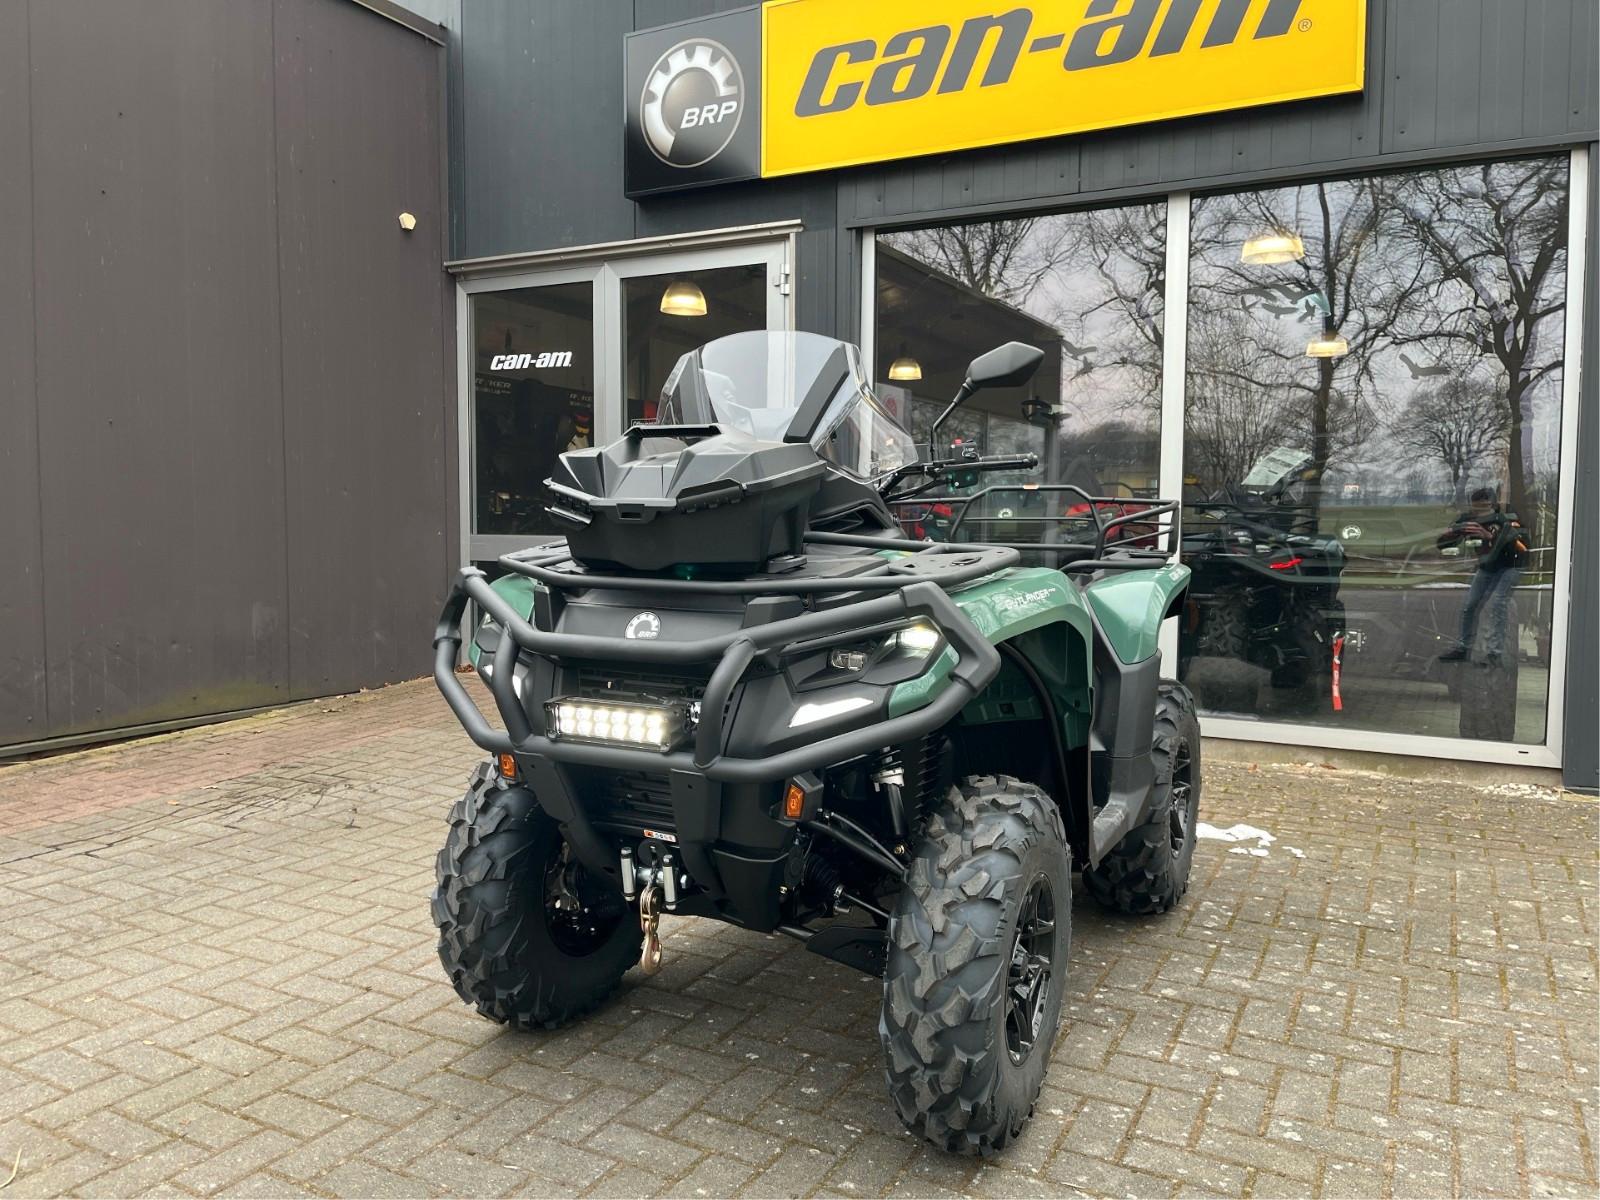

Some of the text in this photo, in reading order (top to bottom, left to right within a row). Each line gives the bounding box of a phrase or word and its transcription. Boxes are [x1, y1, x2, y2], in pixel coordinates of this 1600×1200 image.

[680, 101, 738, 128] BRP
[490, 351, 572, 370] can-am
[1005, 589, 1050, 609] OUTLANDER
